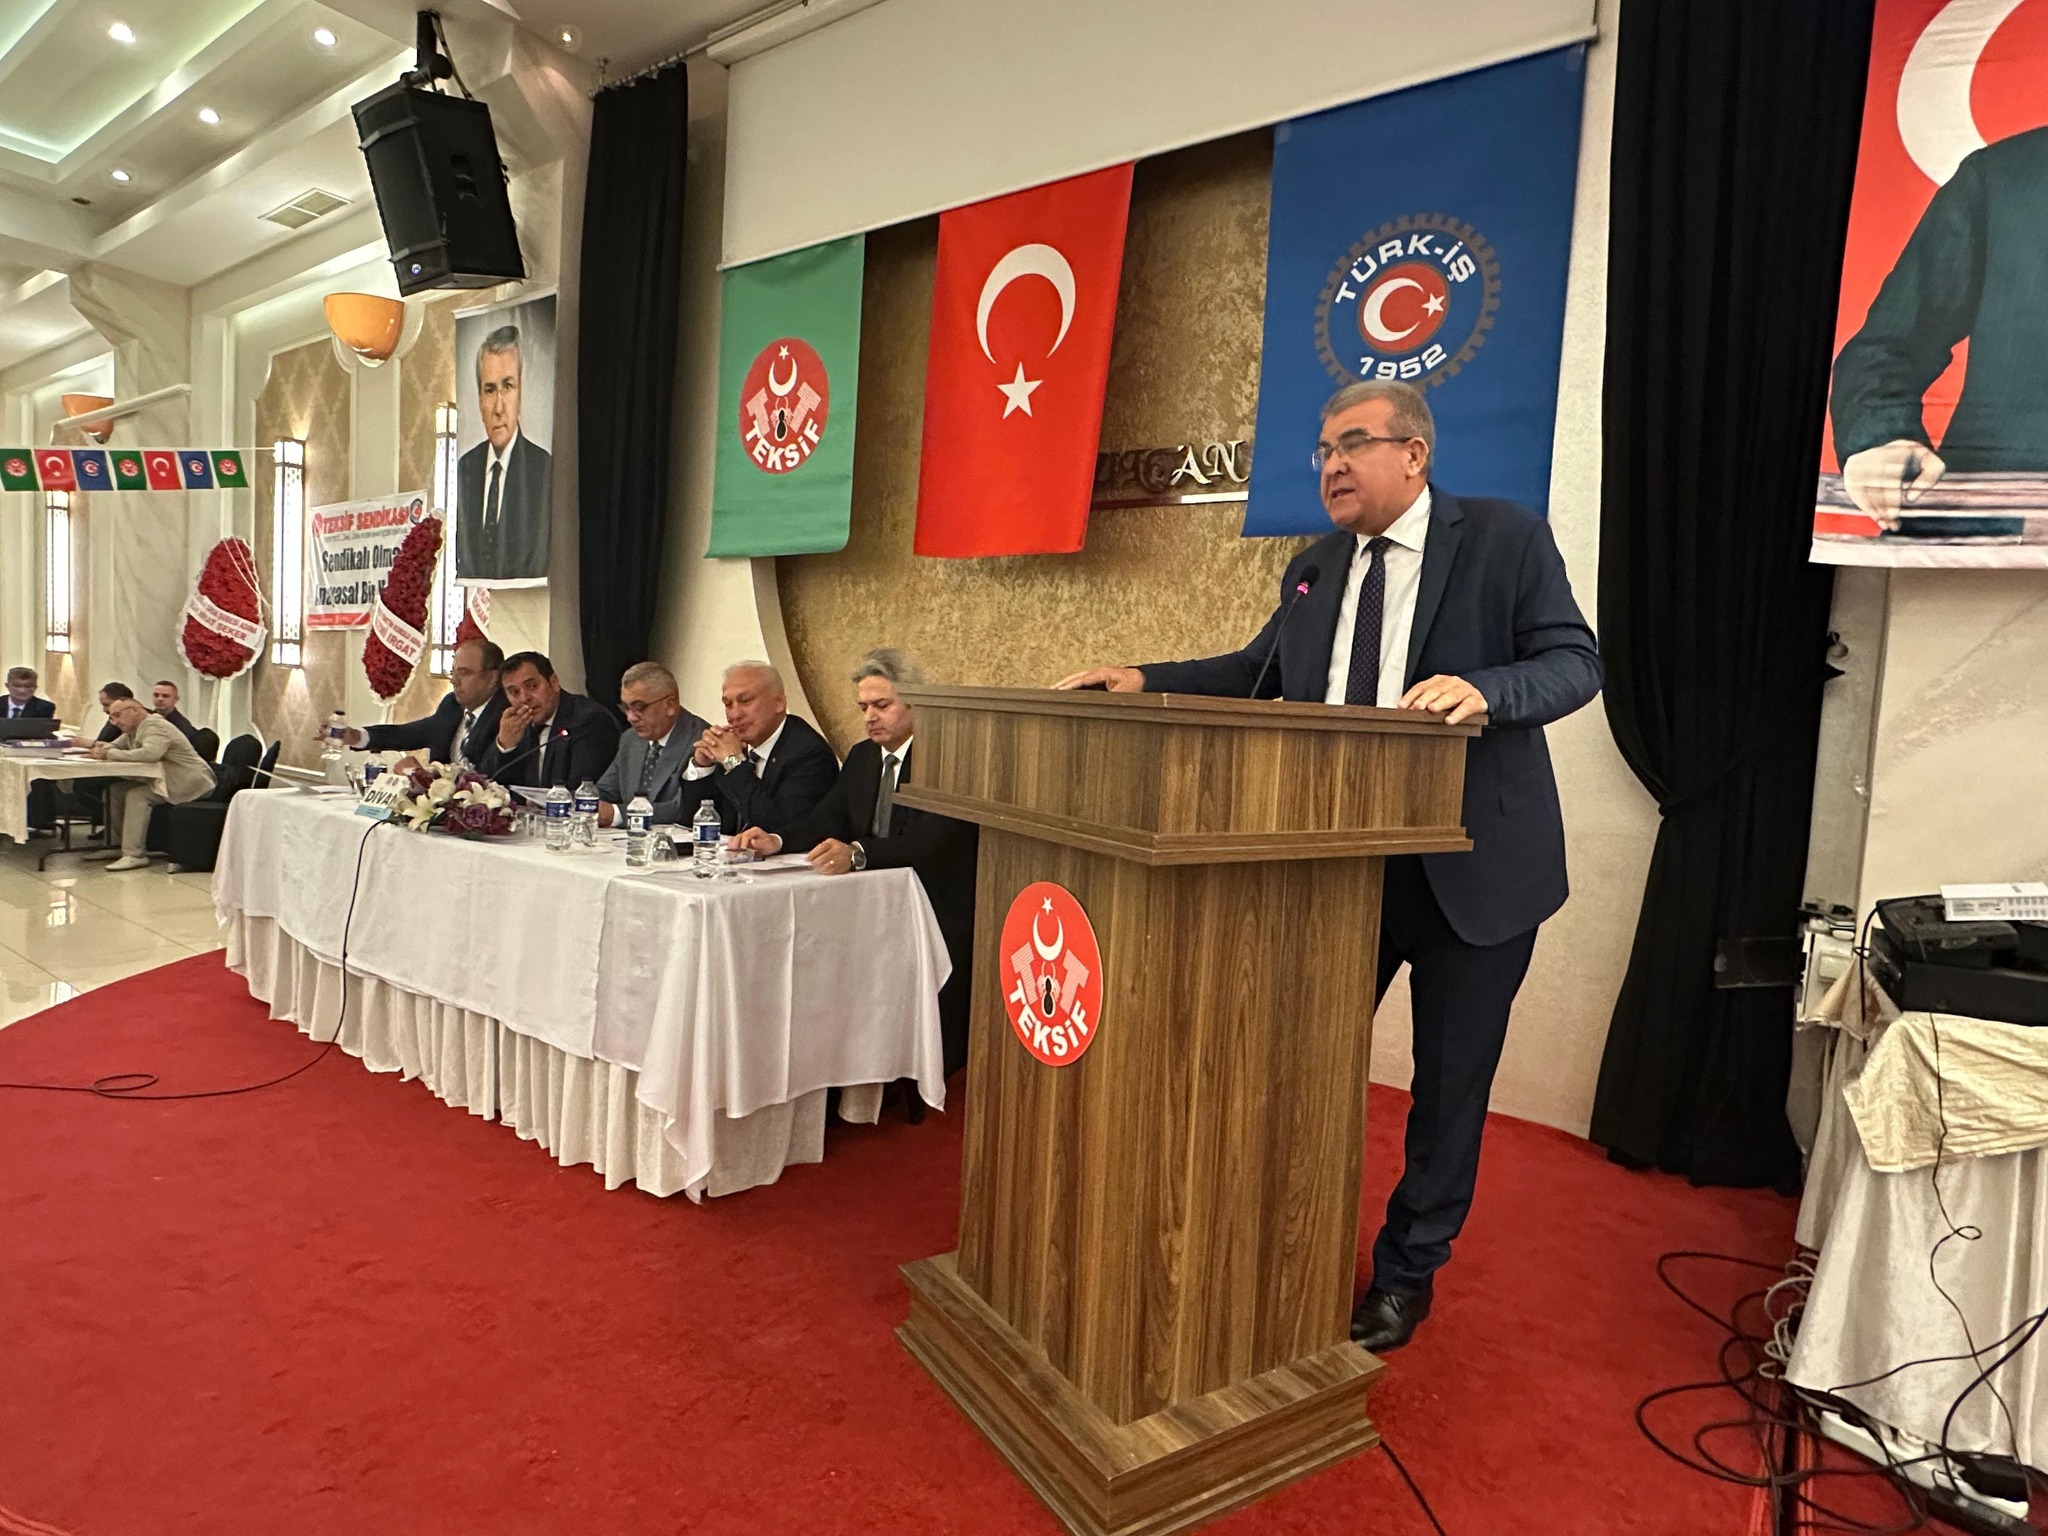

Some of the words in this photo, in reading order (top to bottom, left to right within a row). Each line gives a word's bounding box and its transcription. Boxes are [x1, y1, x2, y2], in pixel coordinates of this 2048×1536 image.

[1335, 234, 1476, 304] TÜRK-İŞ
[1360, 344, 1447, 381] 1952
[356, 505, 410, 531] SENDİKASI
[322, 546, 370, 572] Sendikalı
[361, 580, 376, 604] Bir
